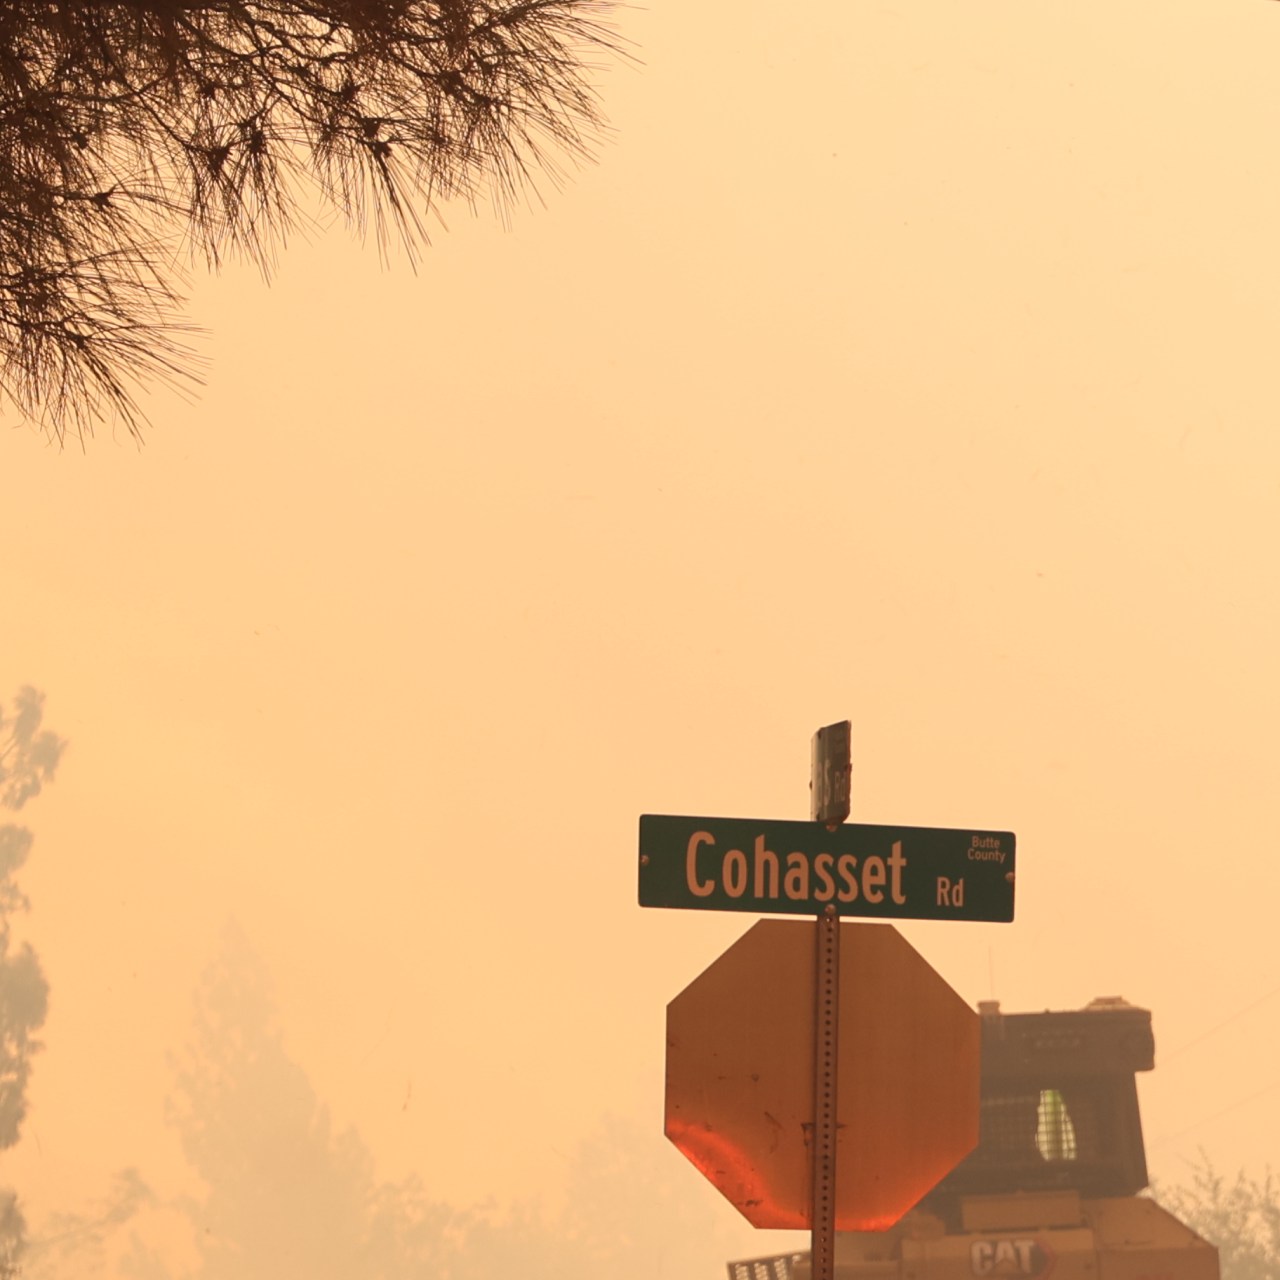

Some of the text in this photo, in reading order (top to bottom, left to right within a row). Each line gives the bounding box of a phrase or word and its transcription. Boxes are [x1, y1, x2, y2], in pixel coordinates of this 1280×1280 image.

[971, 835, 1001, 849] Butte
[686, 830, 965, 907] Cohasset Rd
[967, 848, 1006, 864] County
[971, 1239, 1036, 1276] CAT
